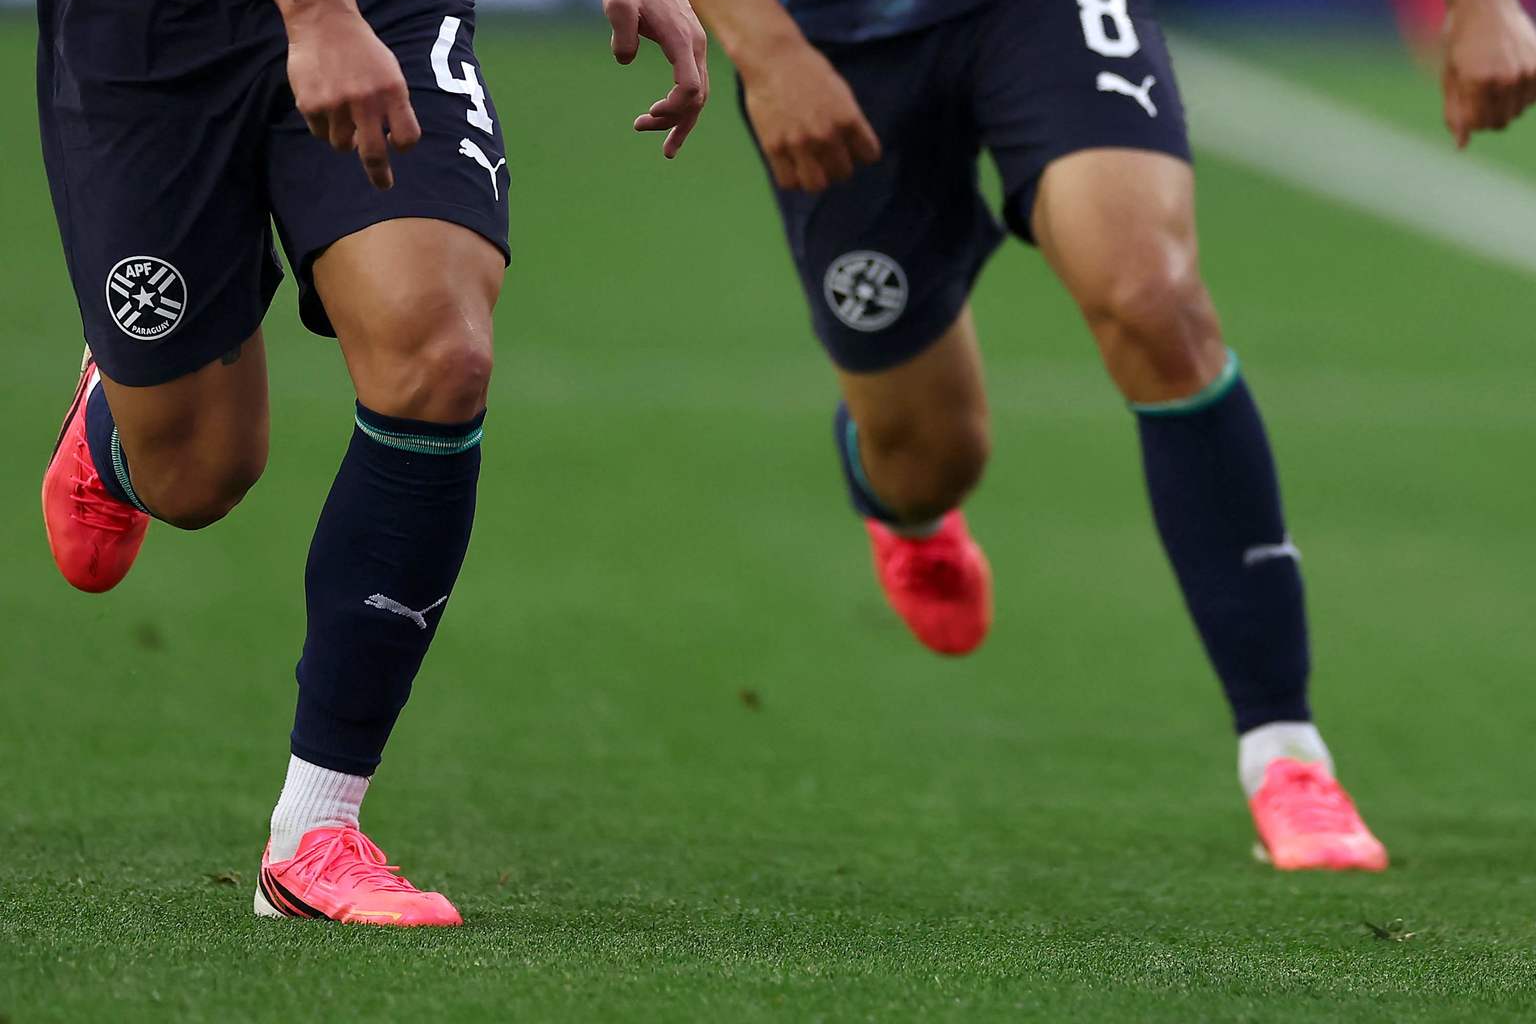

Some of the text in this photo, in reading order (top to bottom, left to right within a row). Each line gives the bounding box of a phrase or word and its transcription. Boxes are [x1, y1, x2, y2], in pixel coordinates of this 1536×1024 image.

[430, 15, 494, 136] 4
[125, 262, 152, 278] APF
[131, 319, 171, 335] PARAGUAY
